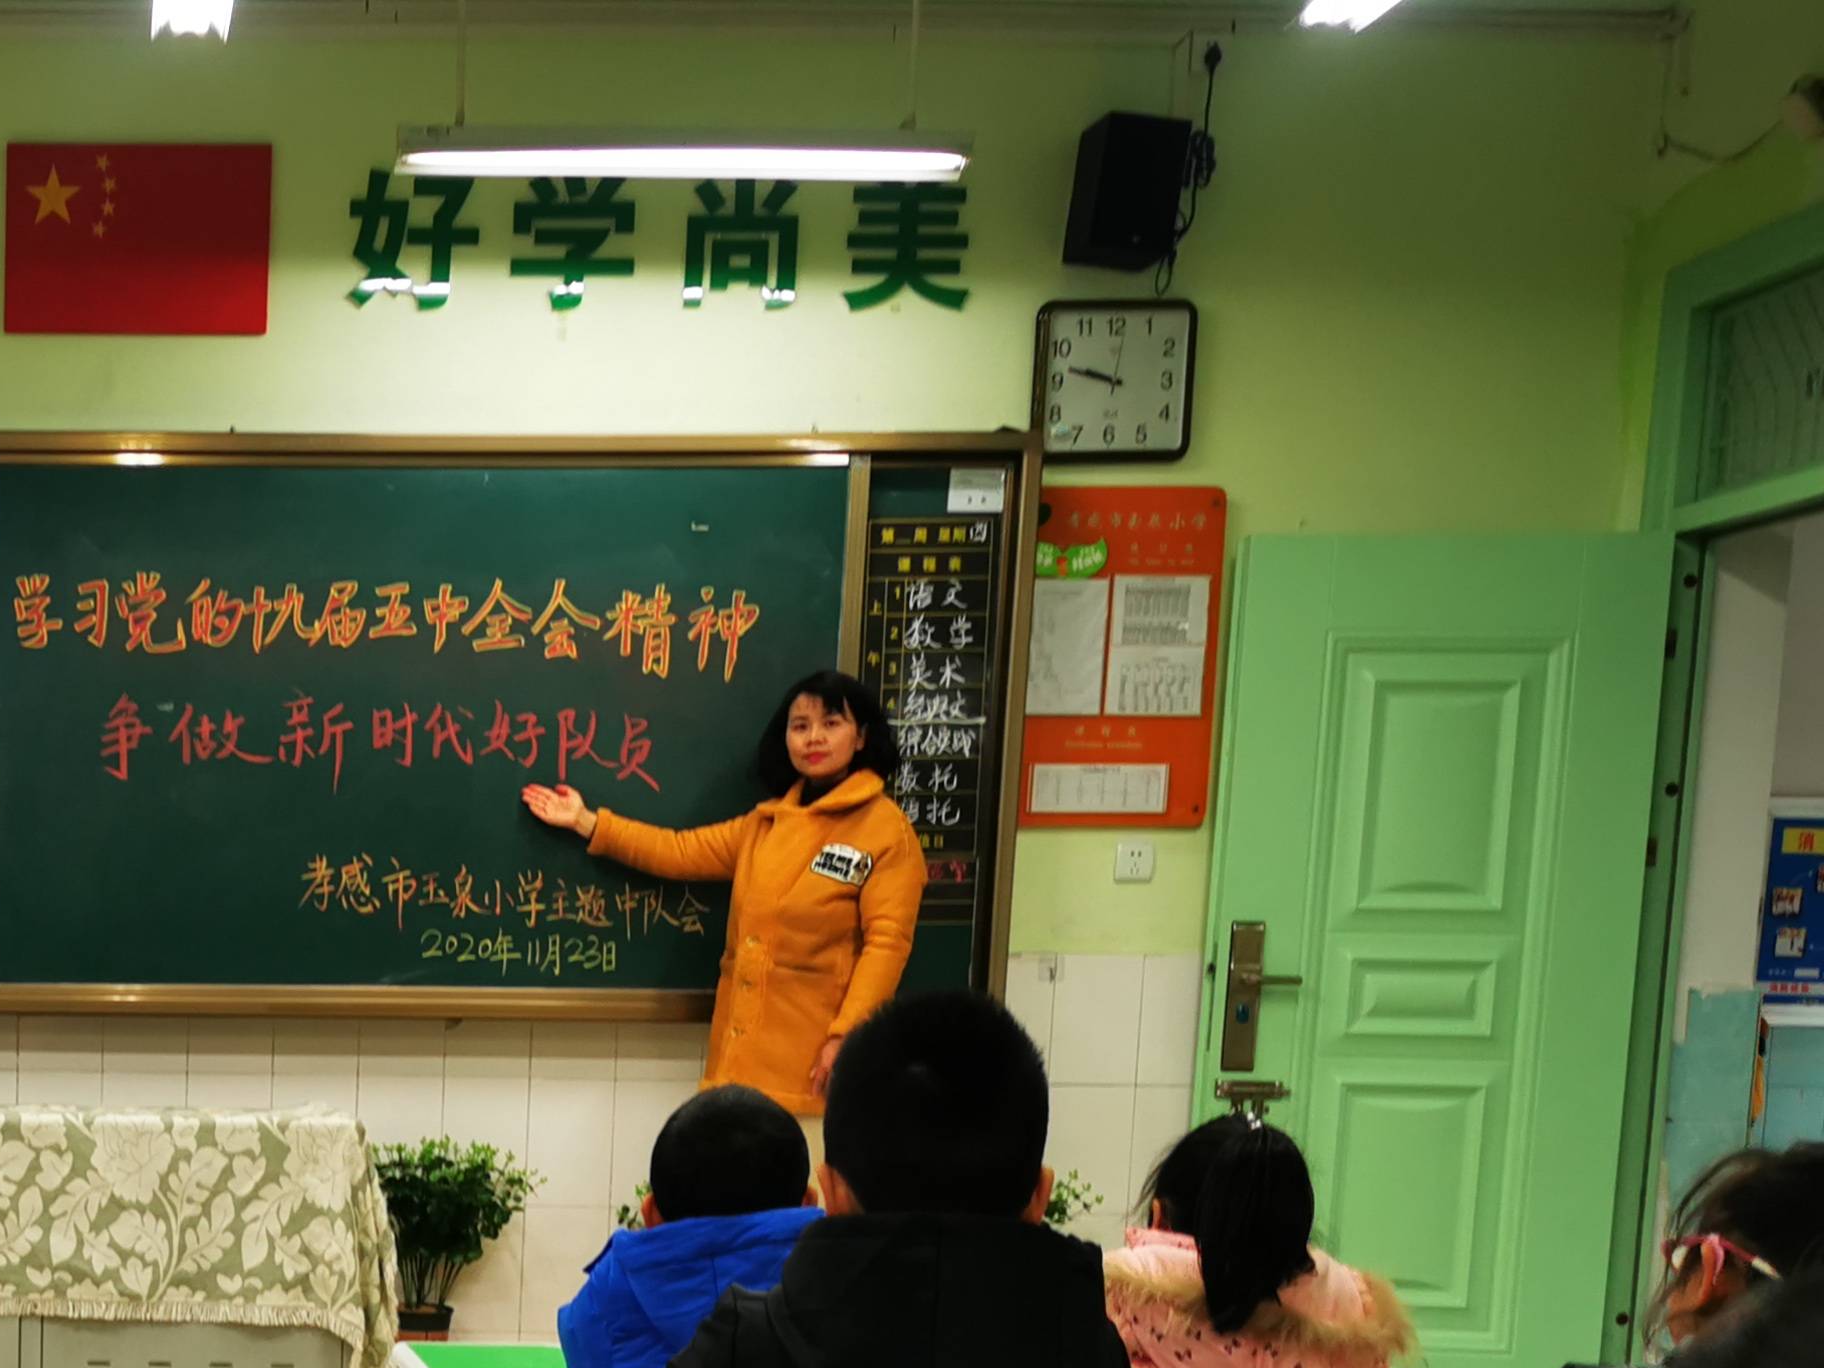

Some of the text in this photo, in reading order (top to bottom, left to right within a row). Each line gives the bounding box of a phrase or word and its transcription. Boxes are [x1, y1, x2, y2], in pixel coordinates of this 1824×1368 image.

[346, 168, 969, 311] 好学尚美
[1078, 317, 1093, 336] 11
[1107, 317, 1126, 336] 12
[1146, 317, 1153, 336] 1
[1052, 338, 1072, 359] 10
[1163, 338, 1176, 358] 2
[1052, 372, 1064, 392] 9
[1160, 370, 1173, 390] 3
[1050, 404, 1062, 424] 8
[1158, 404, 1170, 423] 4
[1072, 425, 1084, 445] 7
[1103, 425, 1115, 444] 6
[1135, 424, 1147, 444] 5
[13, 571, 759, 682] 学习党的十九届五中全会精神
[904, 613, 973, 650] 数学
[908, 651, 965, 690] 美术
[100, 687, 660, 794] 争做新时代好队员
[298, 852, 710, 941] 孝感市玉泉小学主题中队会
[421, 928, 617, 977] 2020年11月23日
